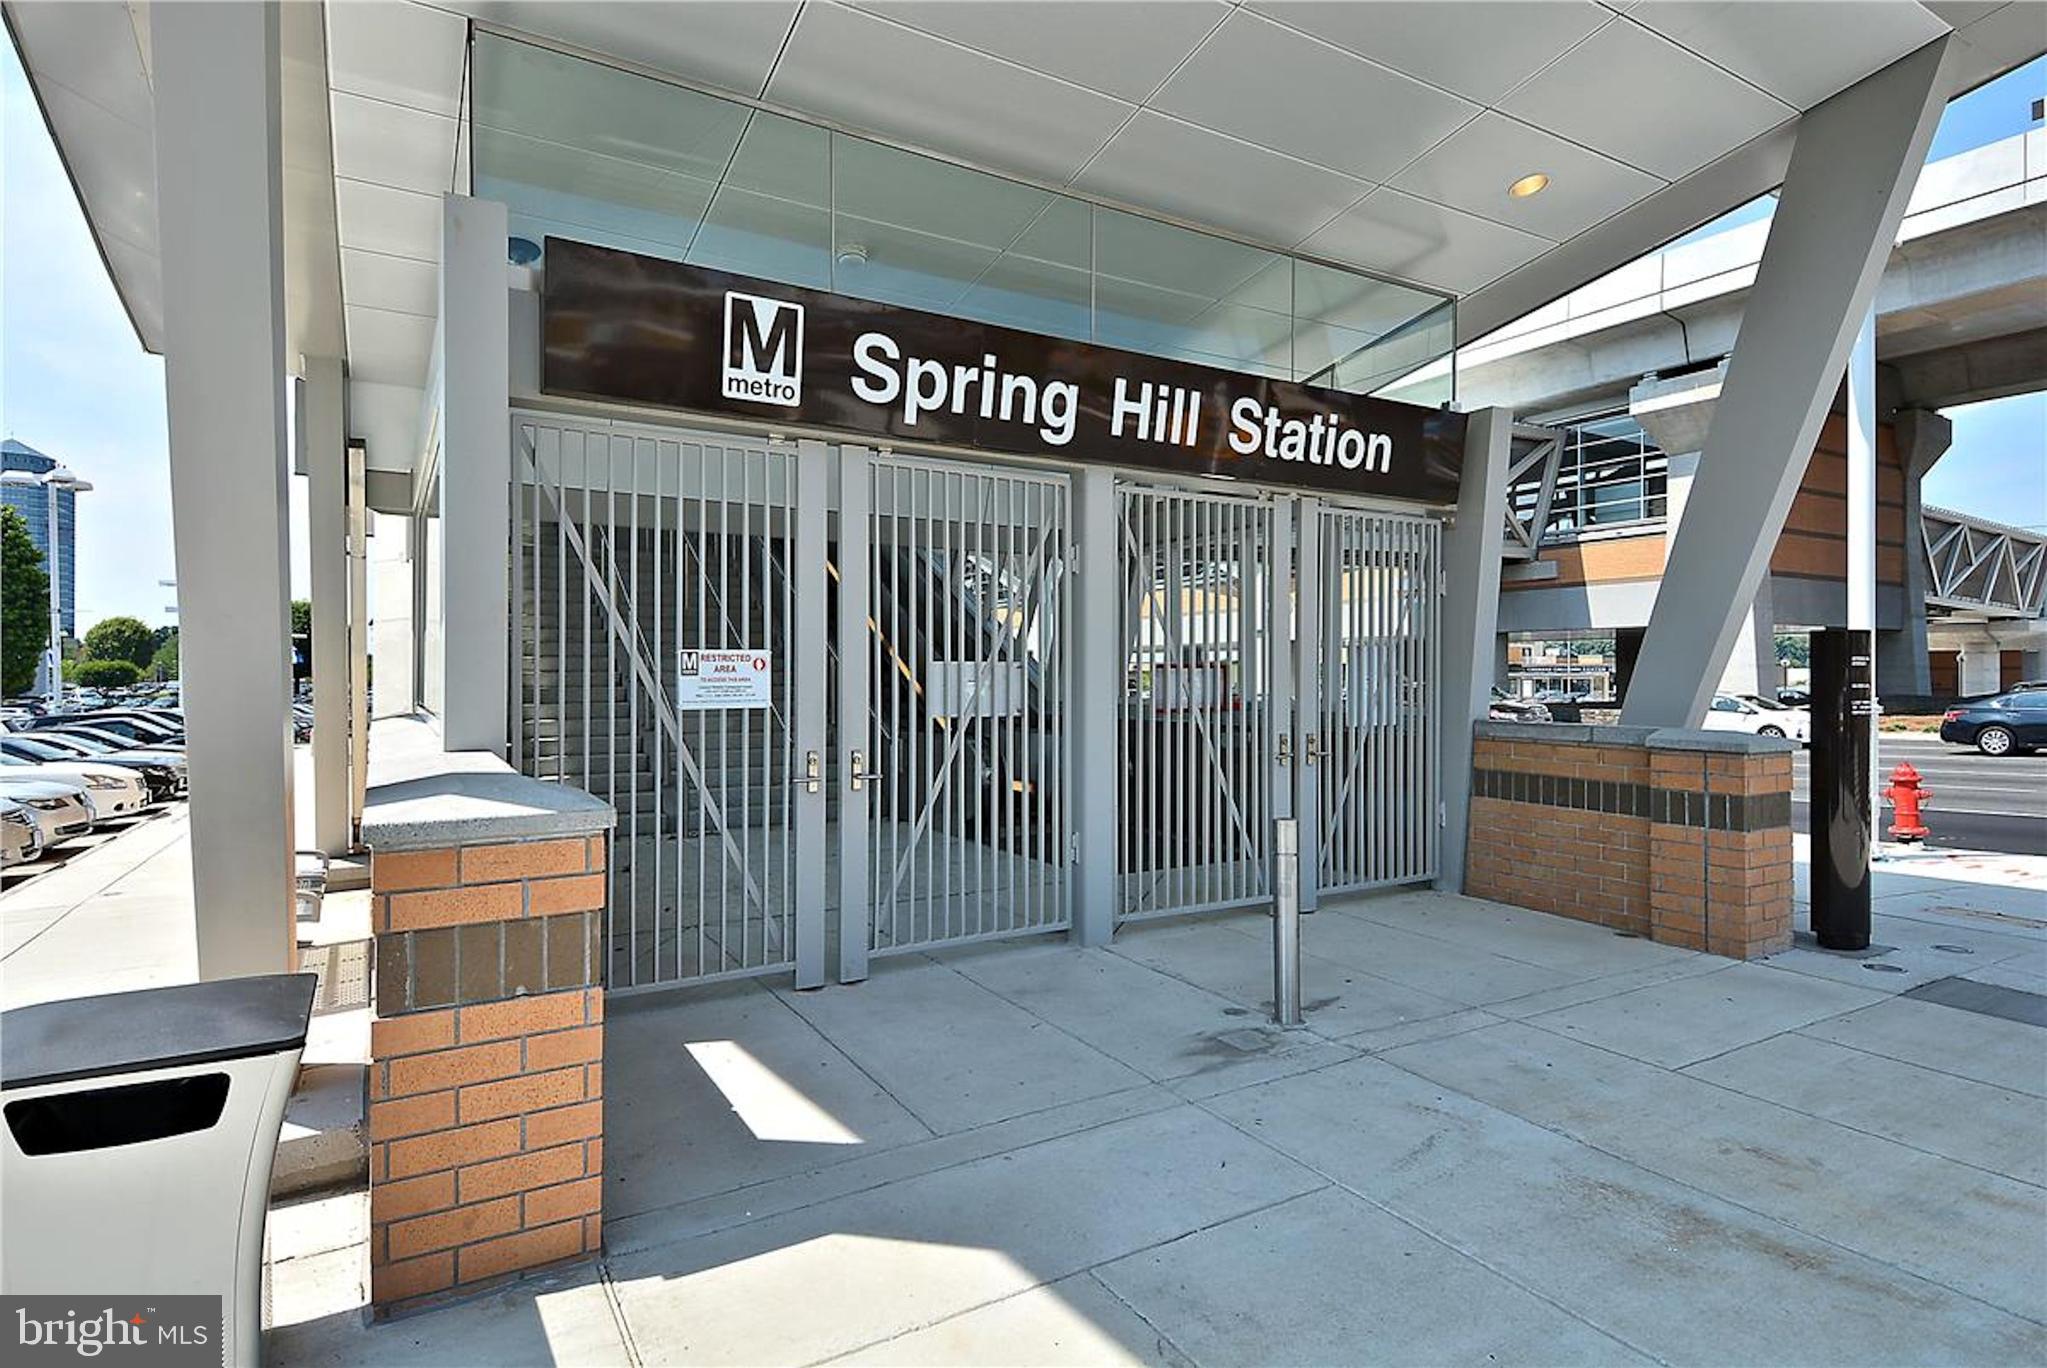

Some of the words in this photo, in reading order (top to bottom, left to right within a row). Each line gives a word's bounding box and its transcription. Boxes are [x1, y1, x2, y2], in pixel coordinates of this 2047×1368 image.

[729, 292, 798, 378] M
[728, 375, 796, 402] metro
[852, 332, 1079, 445] Spring
[1111, 377, 1201, 448] Hill
[1229, 397, 1392, 473] Station
[700, 653, 751, 662] RESTRICTED
[713, 664, 737, 673] AREA
